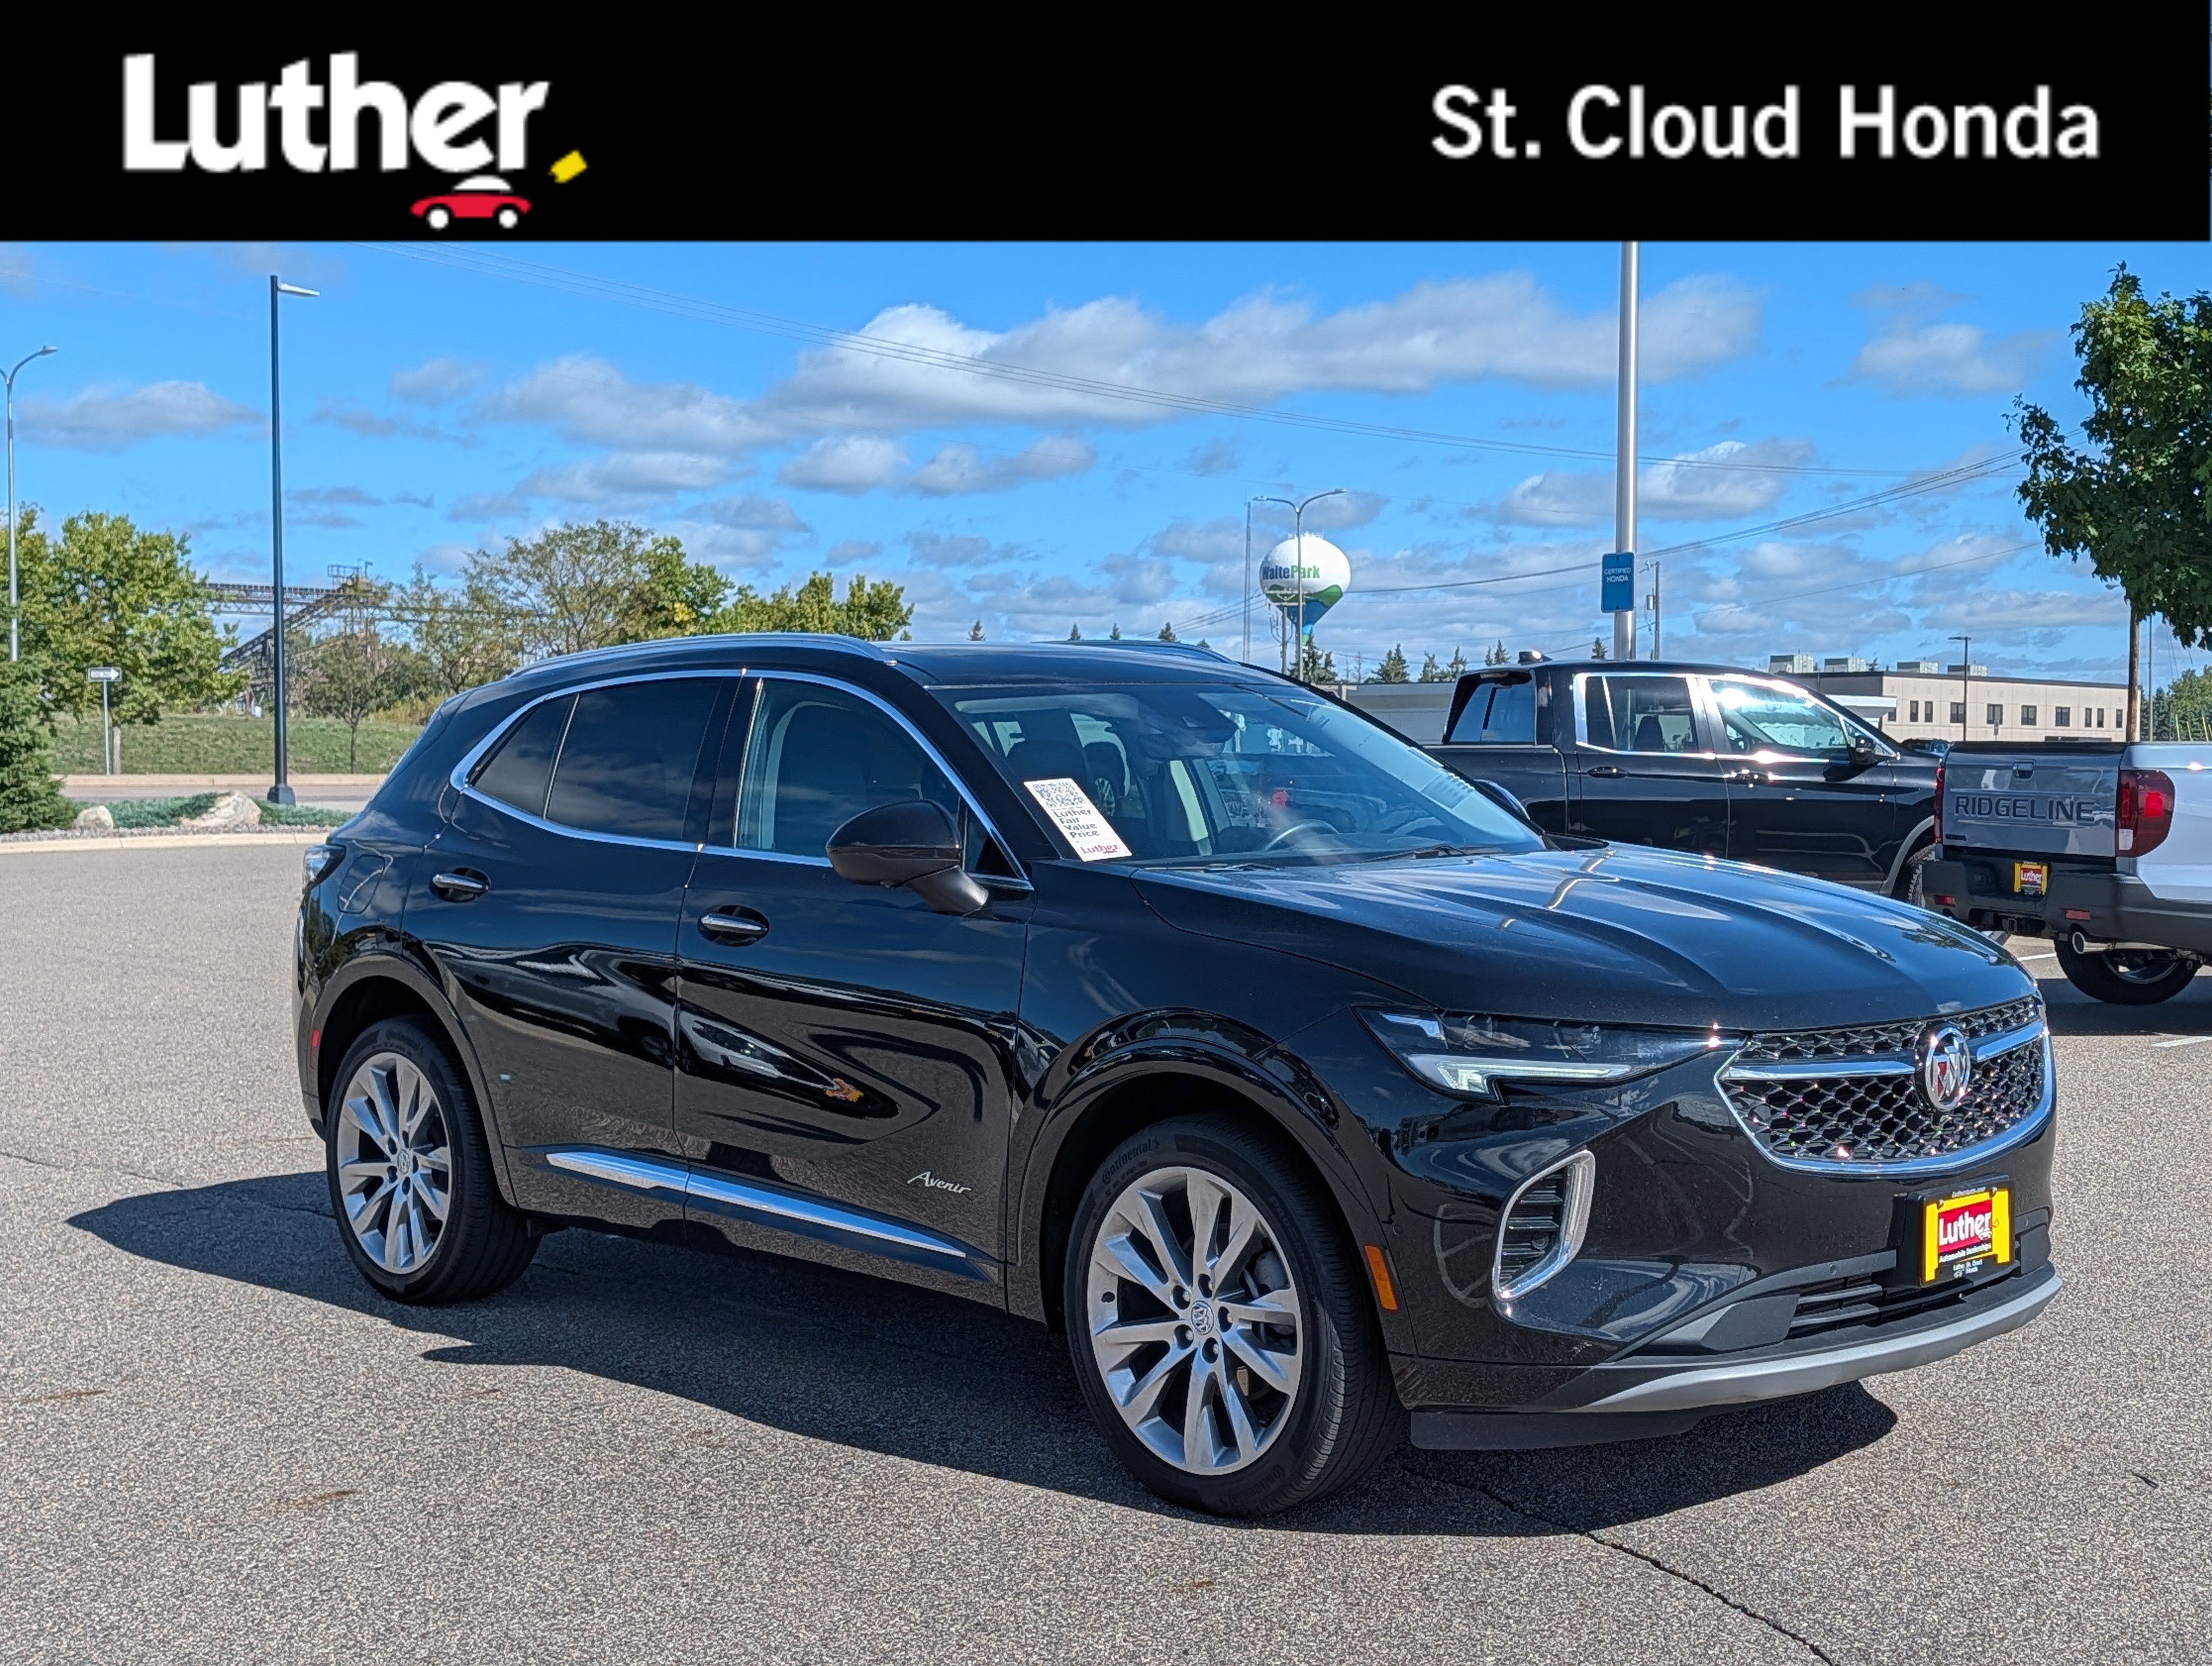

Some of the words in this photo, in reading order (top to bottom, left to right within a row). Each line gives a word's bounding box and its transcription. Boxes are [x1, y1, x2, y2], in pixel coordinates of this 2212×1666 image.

[1053, 809, 1091, 818] Luther
[1955, 795, 2095, 822] RIDGELINE
[1070, 830, 1099, 838] Price
[1081, 844, 1118, 854] Luther
[2021, 869, 2042, 882] Luther
[1102, 1138, 1152, 1184] Continental
[907, 1171, 972, 1194] Avenir
[1939, 1211, 1992, 1246] Luther
